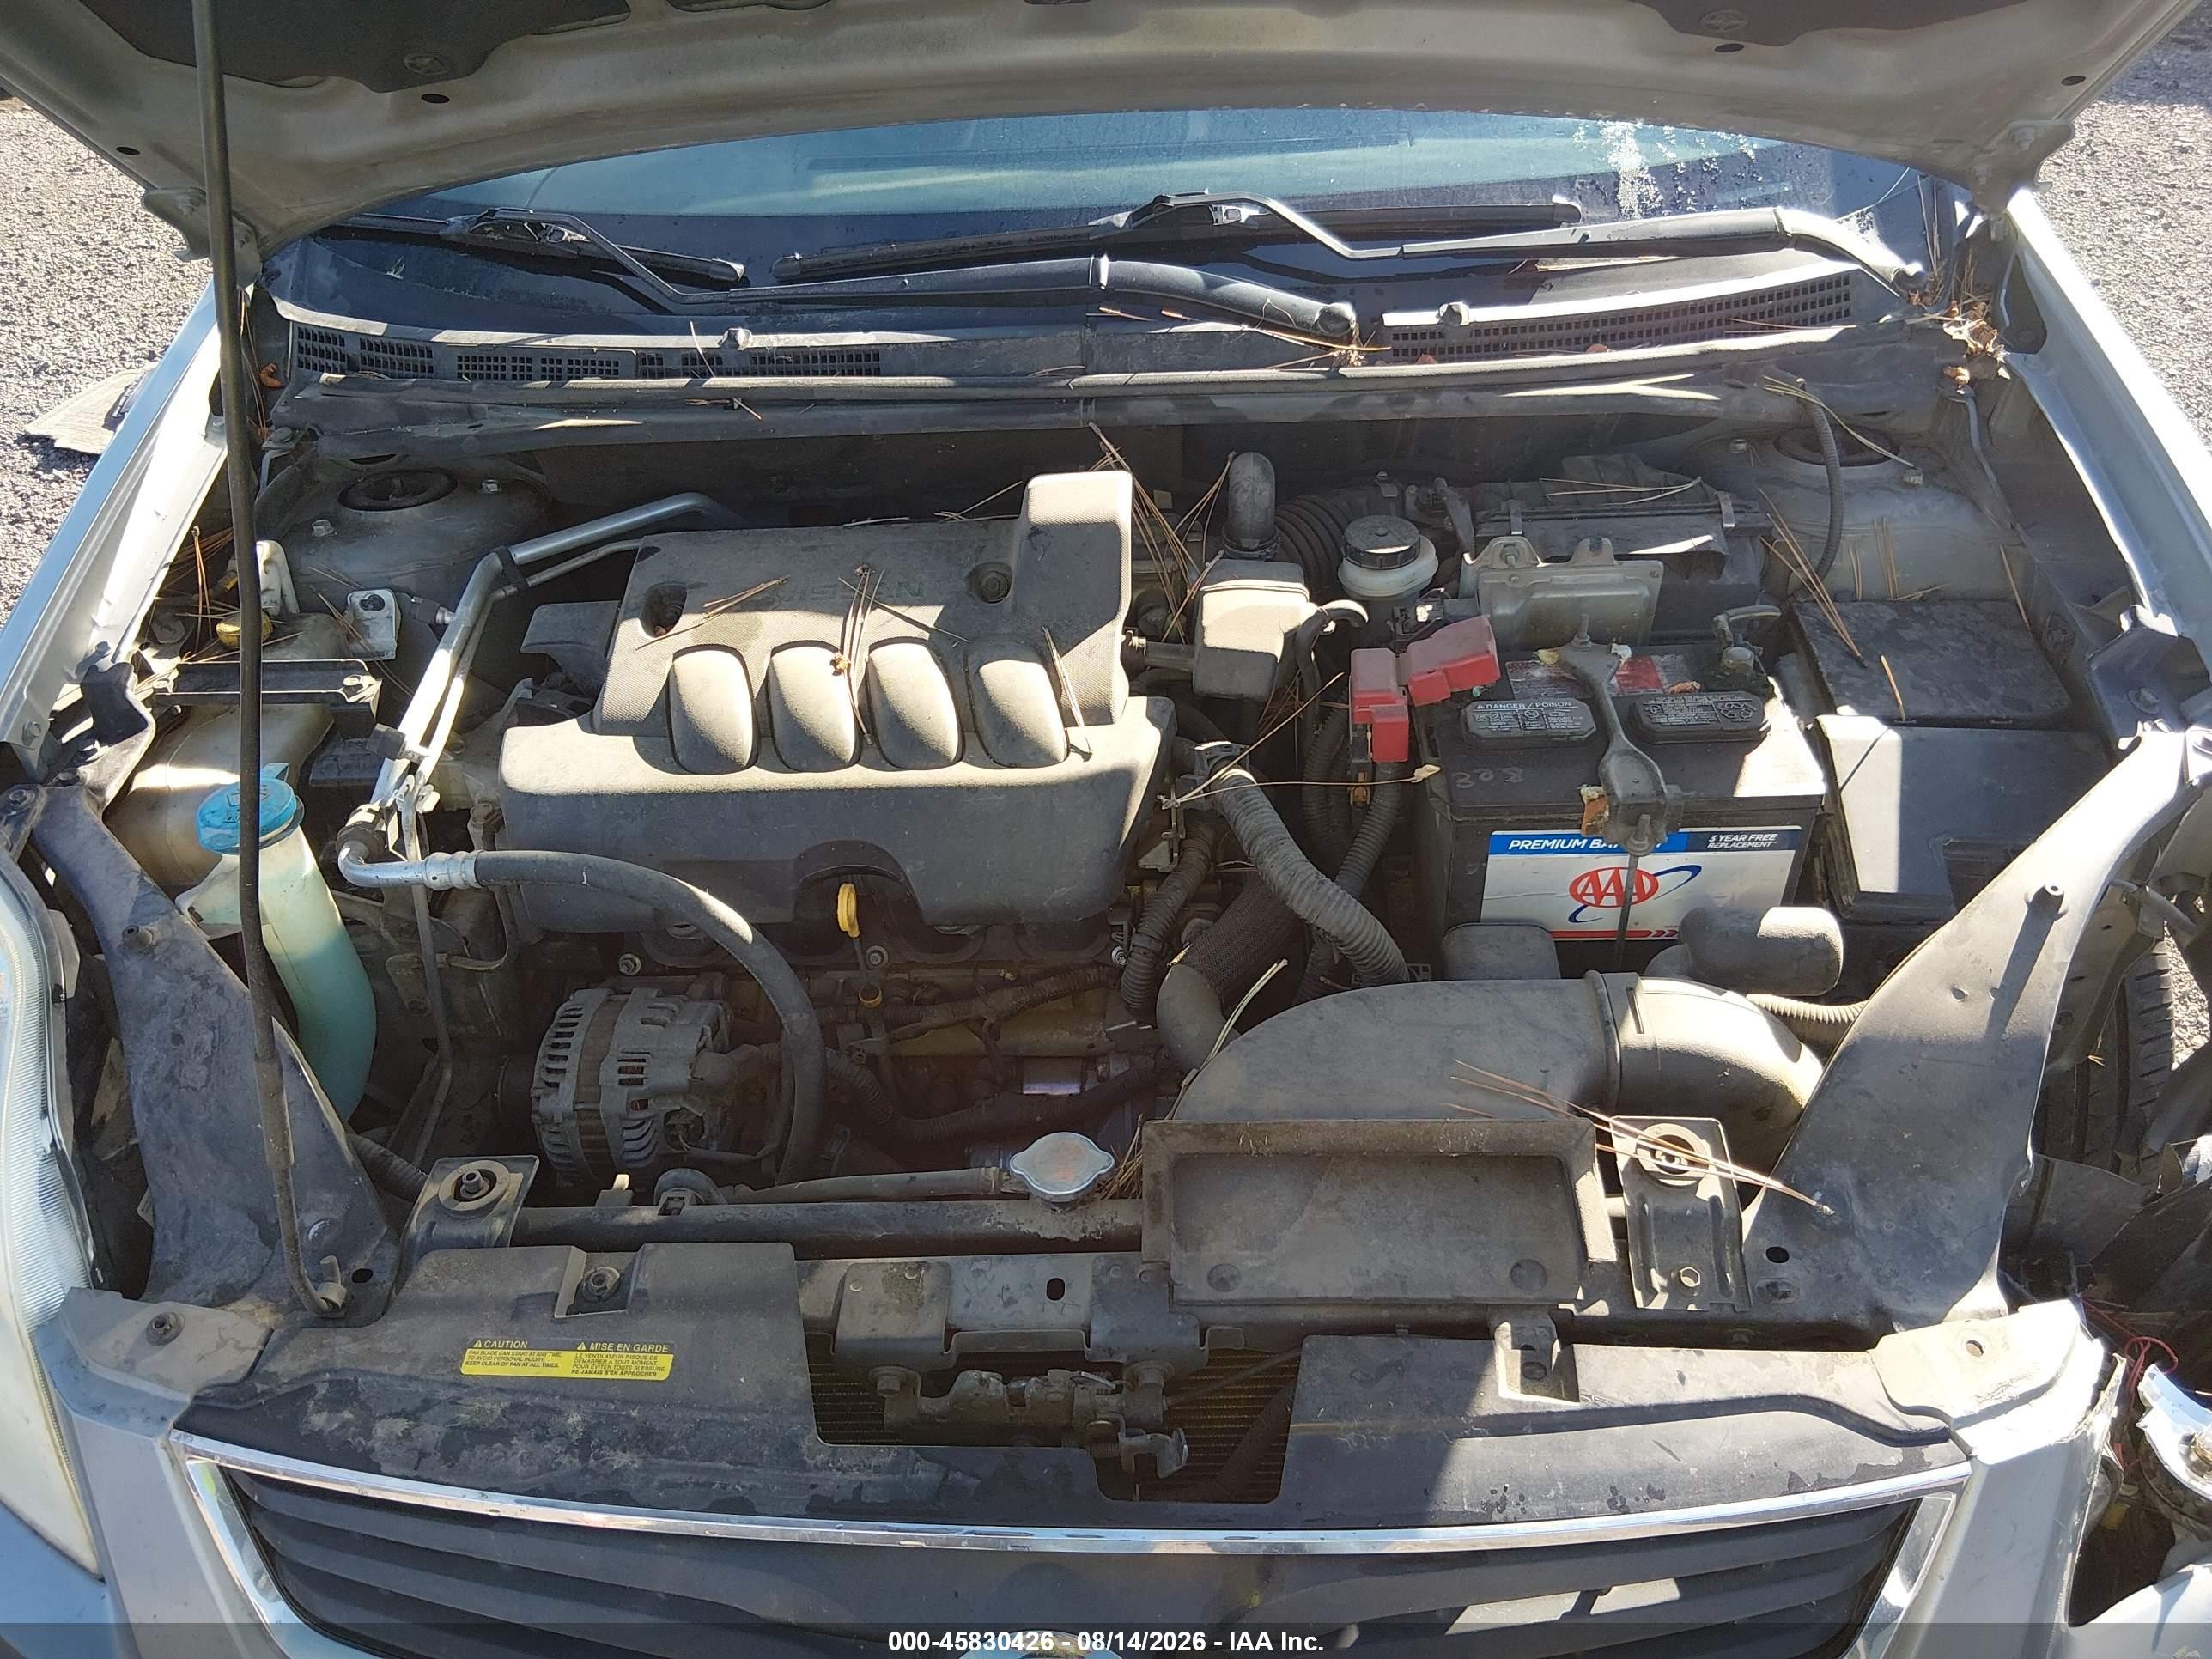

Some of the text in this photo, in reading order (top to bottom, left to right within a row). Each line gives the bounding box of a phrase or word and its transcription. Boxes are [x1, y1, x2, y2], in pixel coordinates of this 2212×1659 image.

[1748, 833, 1778, 842] FREE
[1509, 838, 1587, 850] PREMIUM
[1575, 866, 1658, 908] AAA
[483, 1340, 528, 1348] CAUTION
[590, 1342, 670, 1352] MISE EN GARDE
